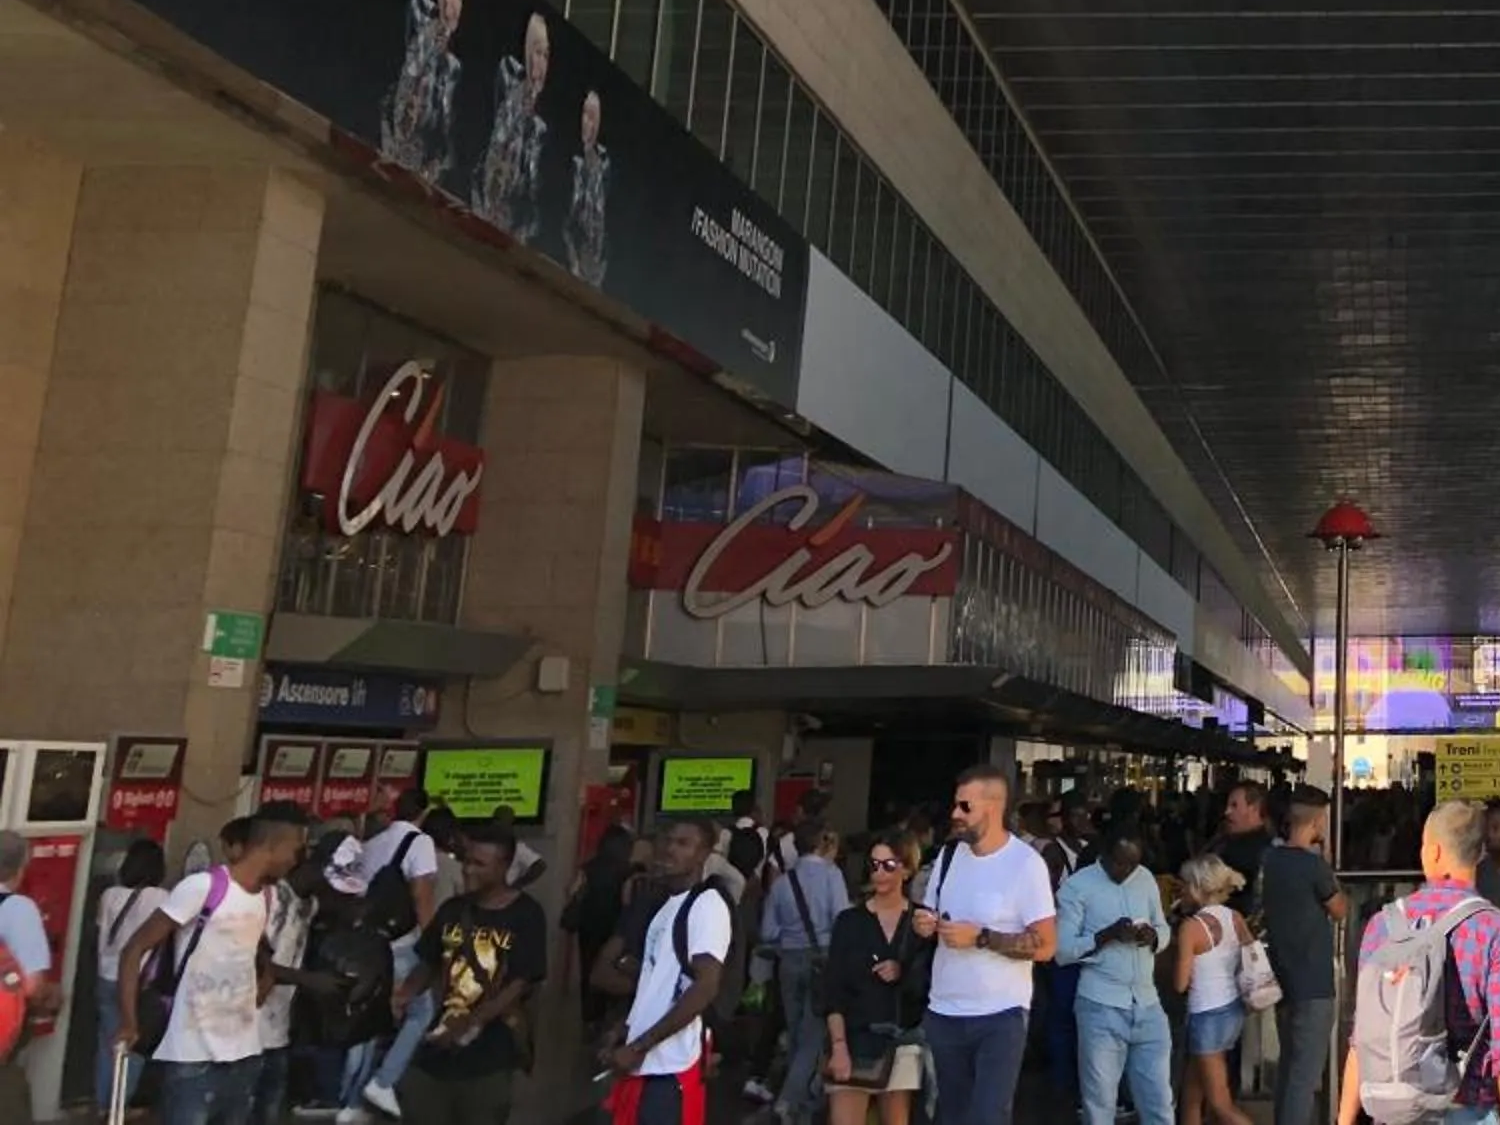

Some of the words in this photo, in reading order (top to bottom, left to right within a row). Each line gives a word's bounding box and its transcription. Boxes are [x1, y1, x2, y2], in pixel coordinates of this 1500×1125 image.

[337, 359, 484, 537] Ciao
[682, 485, 952, 619] Ciao
[276, 674, 349, 707] Ascensore
[1444, 742, 1481, 756] Treni
